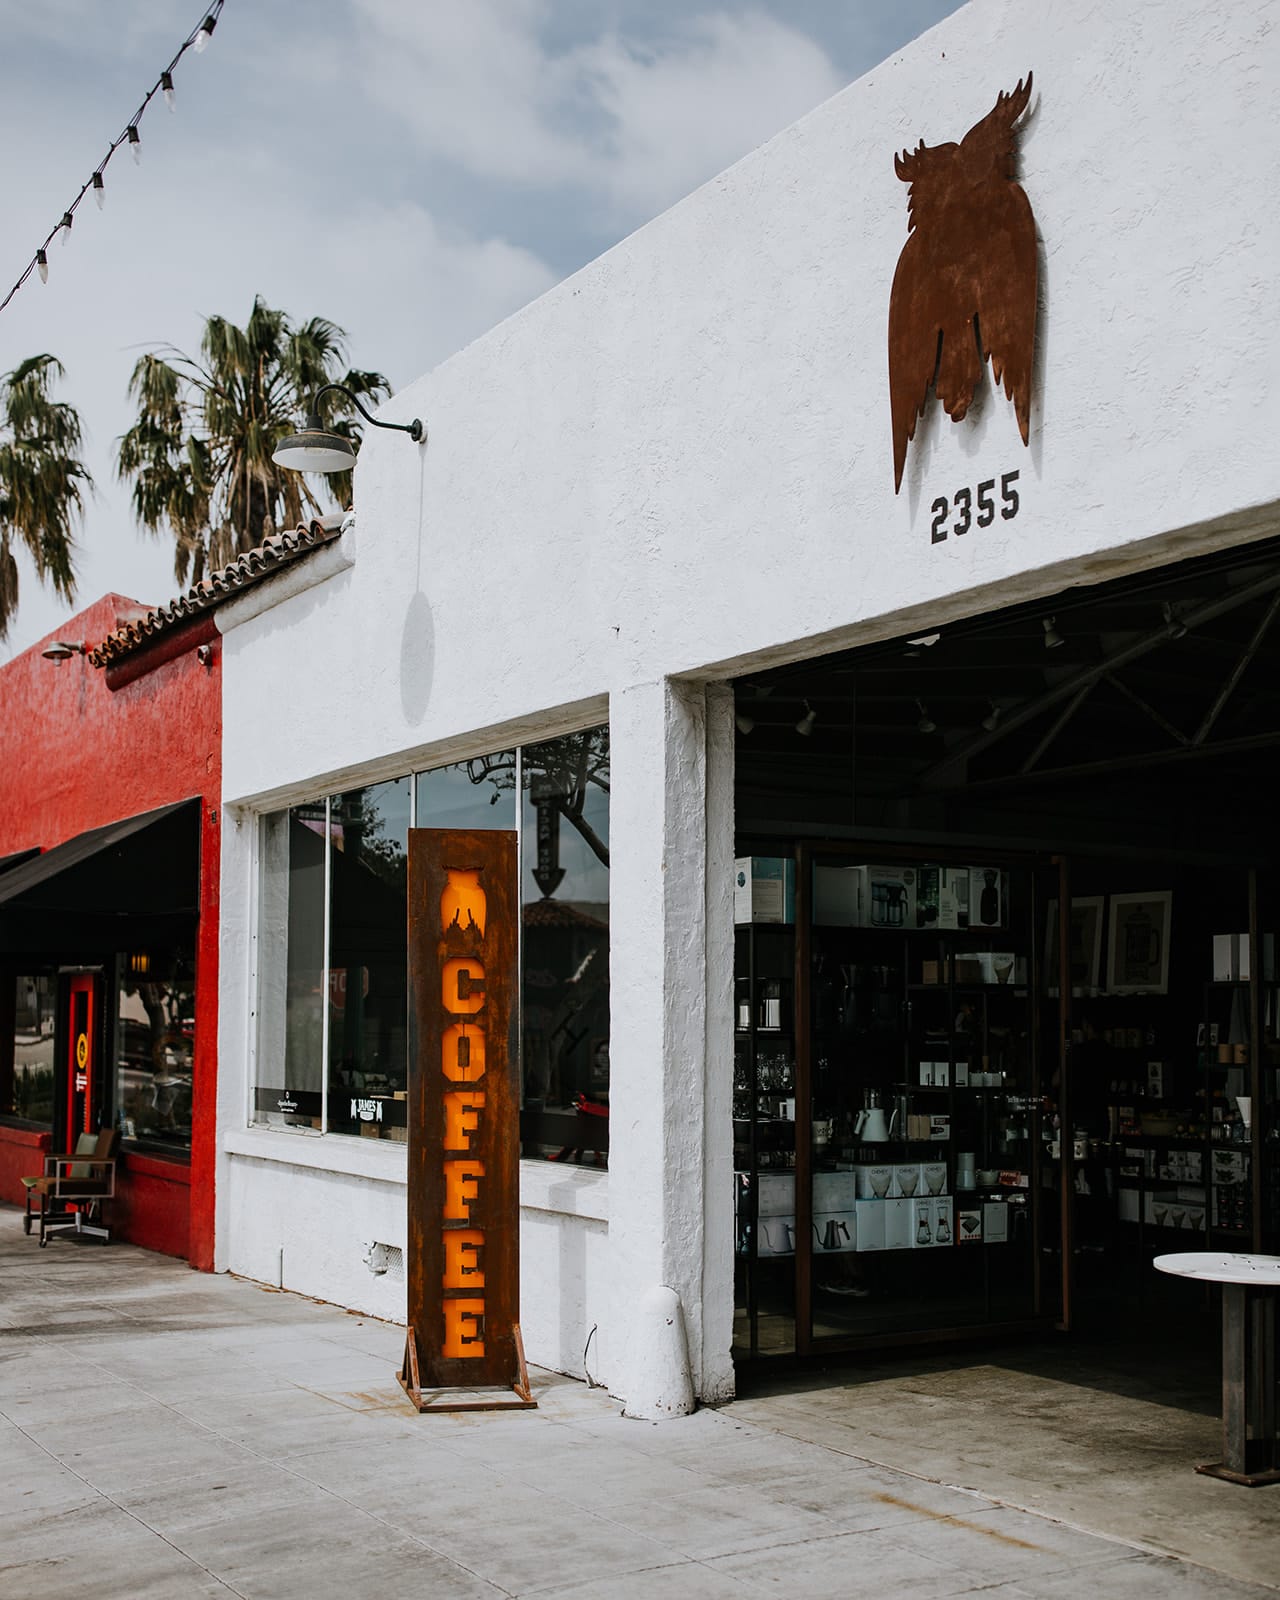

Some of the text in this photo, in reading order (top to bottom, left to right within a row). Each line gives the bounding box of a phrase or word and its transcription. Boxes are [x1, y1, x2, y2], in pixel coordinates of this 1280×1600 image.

[931, 469, 1020, 545] 2355
[357, 1098, 376, 1113] JAMES
[442, 957, 486, 1358] COFFEE
